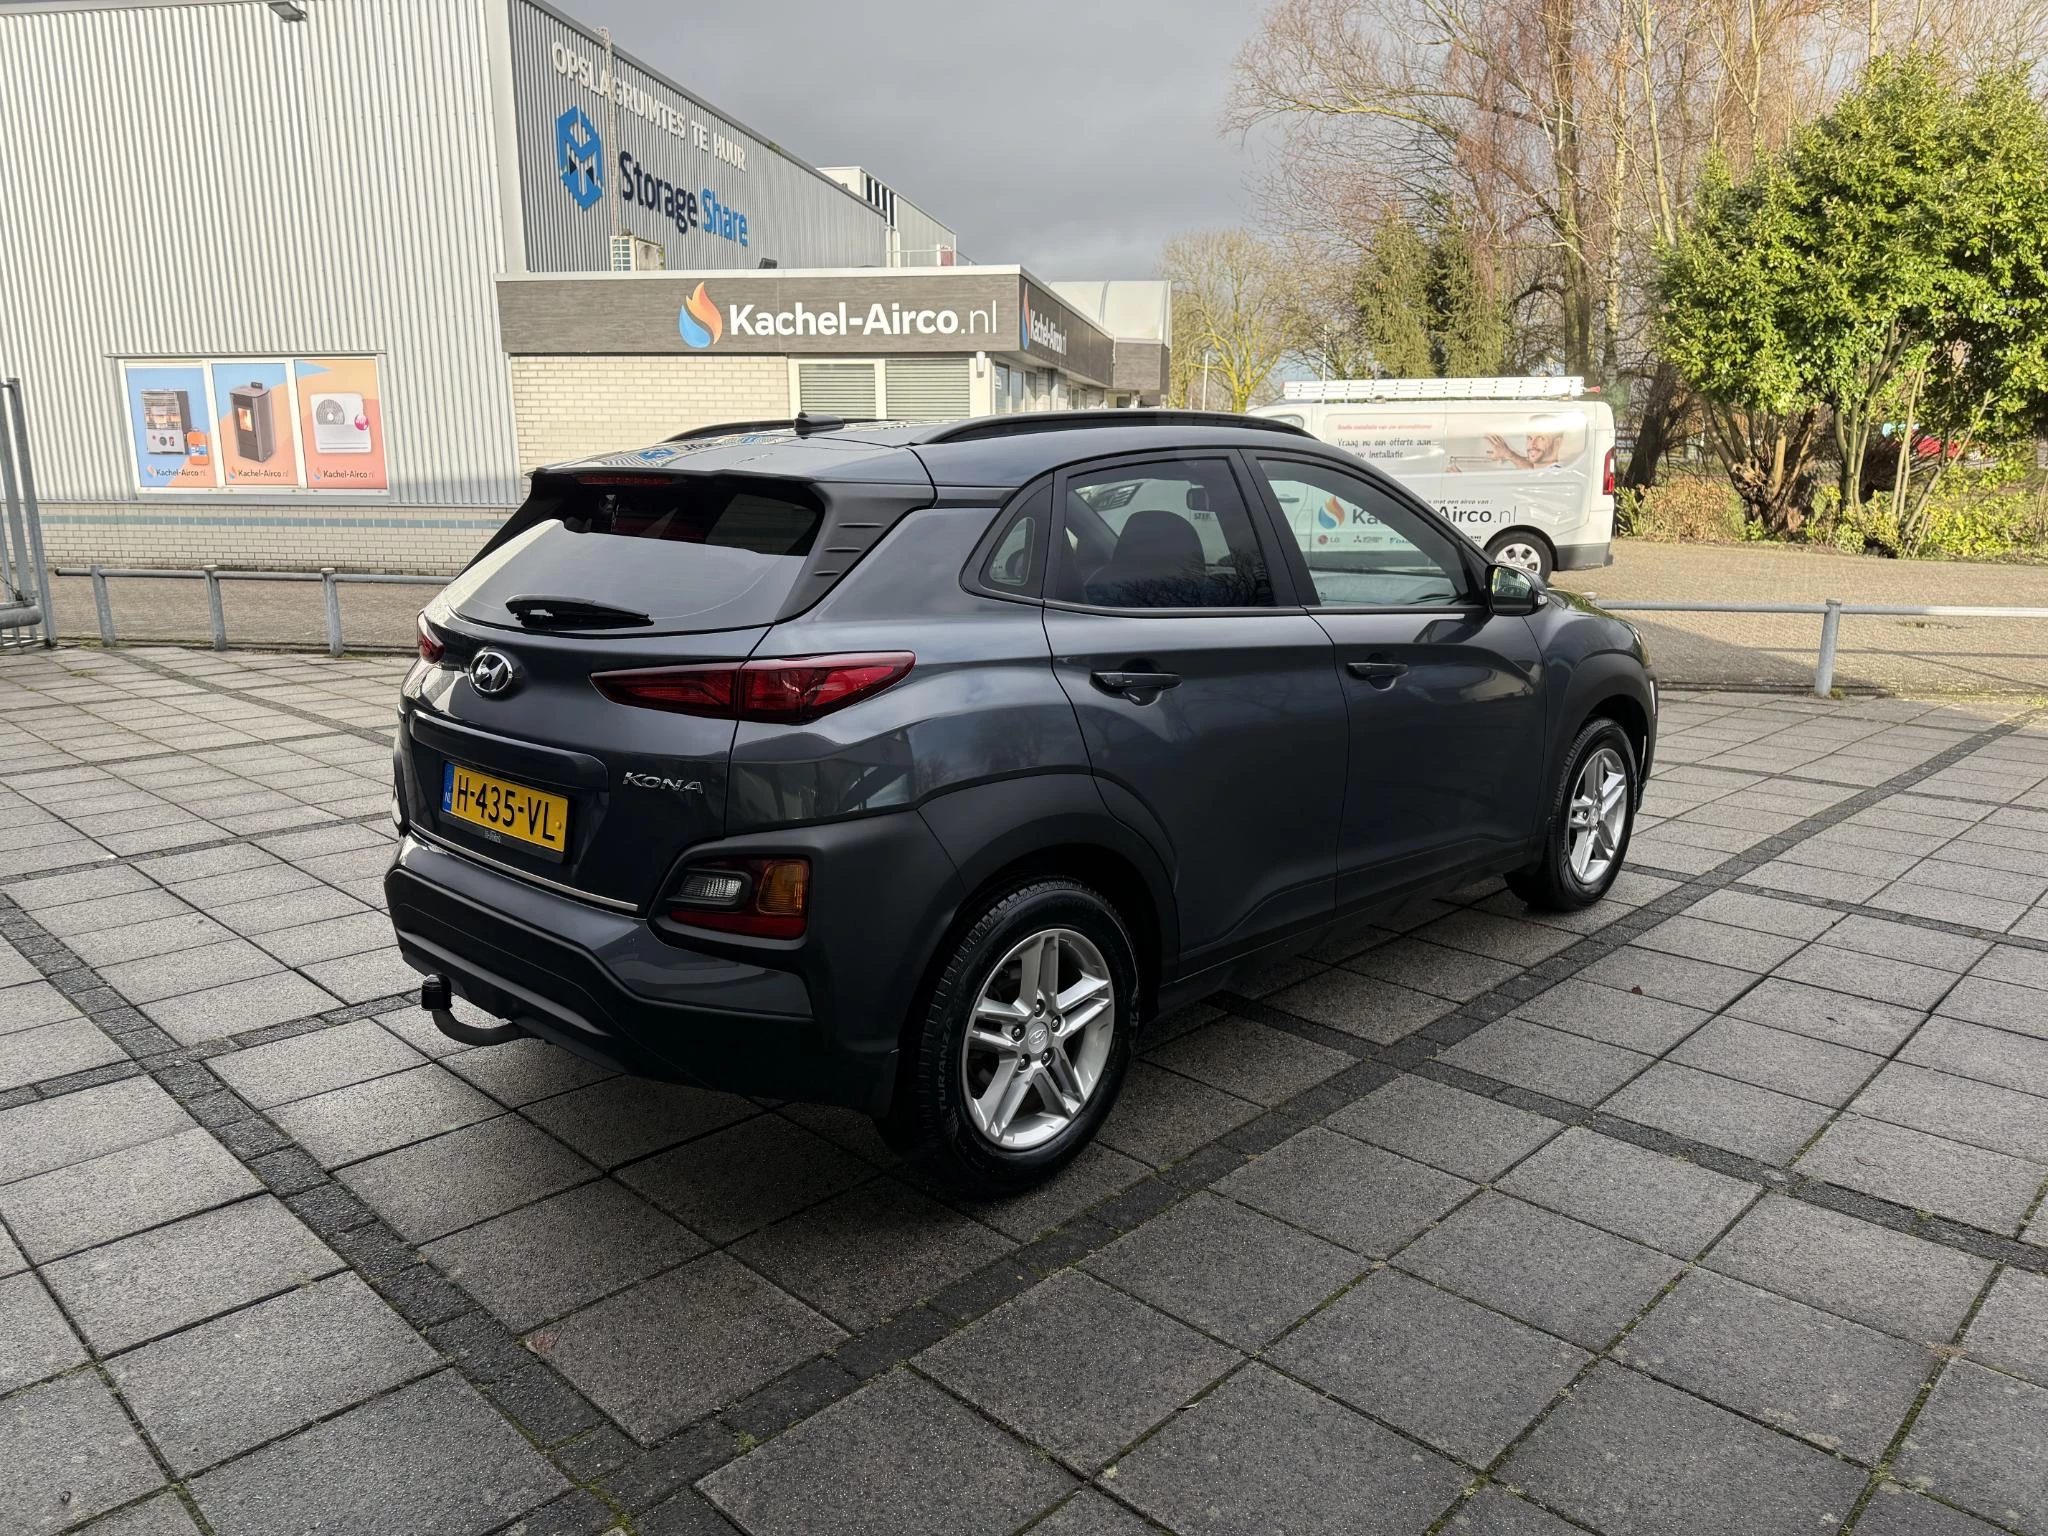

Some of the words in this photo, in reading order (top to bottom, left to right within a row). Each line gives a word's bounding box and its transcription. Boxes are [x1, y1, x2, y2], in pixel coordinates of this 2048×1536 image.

[552, 41, 686, 139] OPSLAGRUIMTES
[691, 120, 709, 152] TE
[713, 132, 747, 172] HUUR
[619, 150, 698, 234] Storage
[702, 188, 748, 247] Share
[729, 299, 998, 336] Kachel-Airco.nl
[1337, 438, 1359, 448] Vraag
[1416, 439, 1432, 447] aan
[457, 774, 556, 842] H-435-VL
[622, 771, 703, 794] KONA
[937, 1016, 954, 1112] TURANZA
